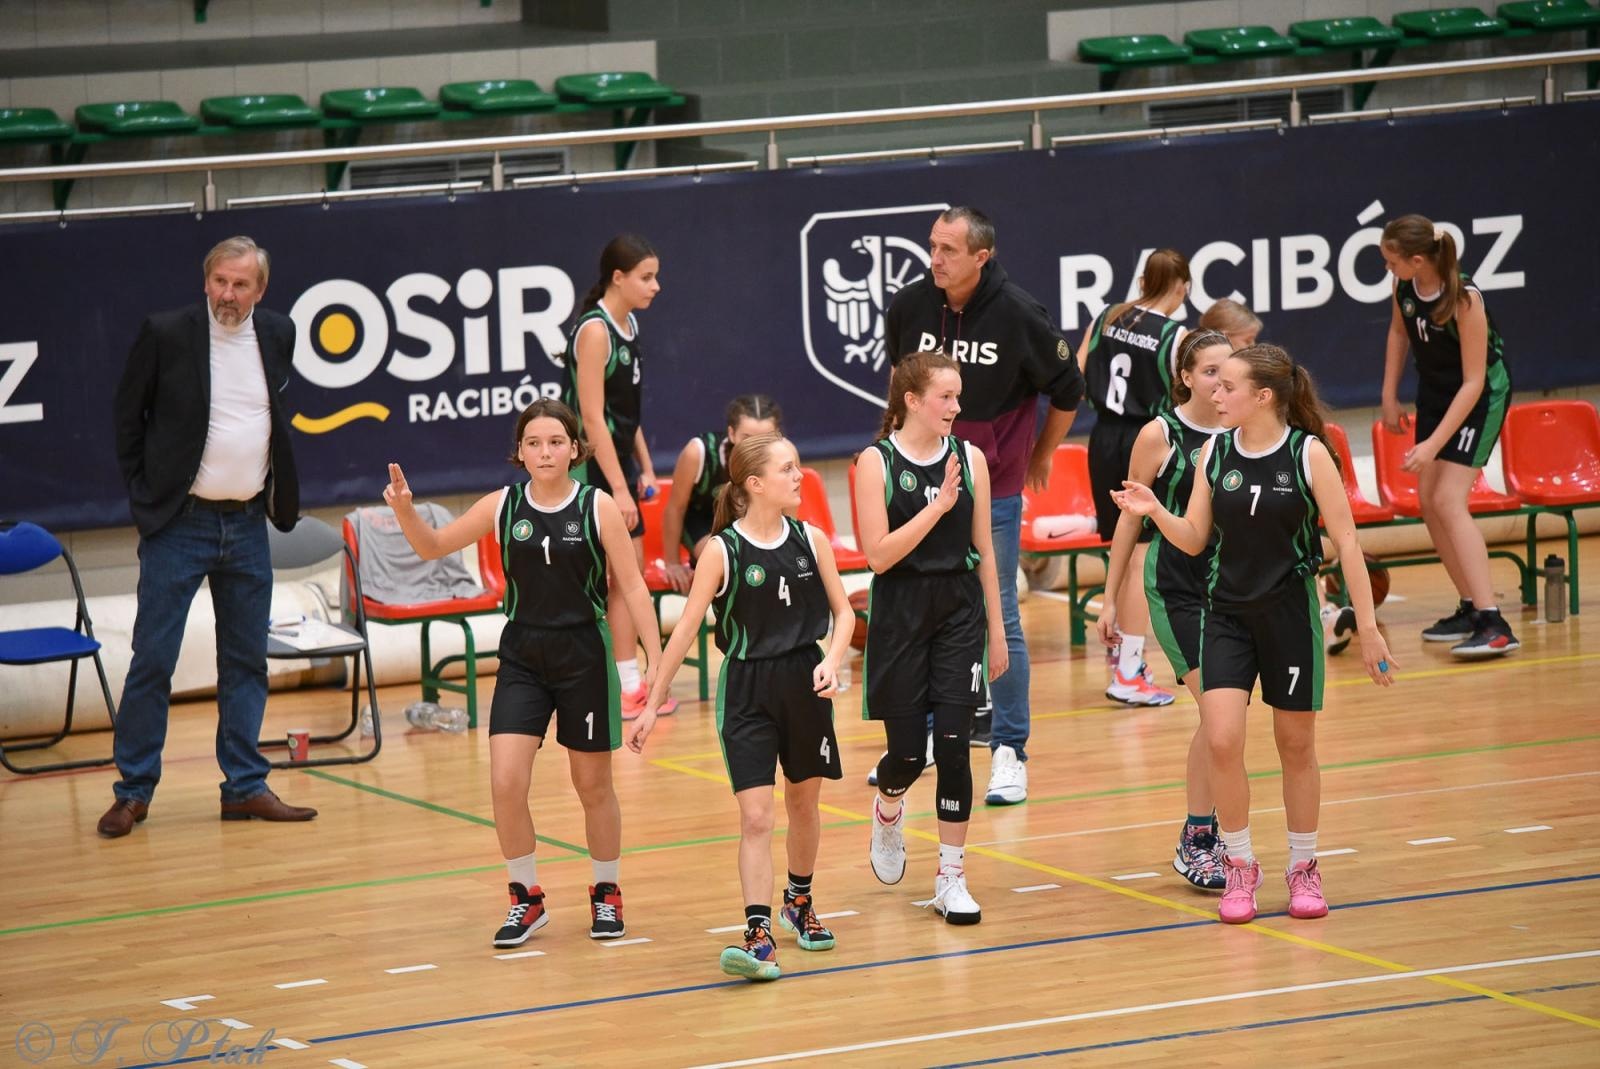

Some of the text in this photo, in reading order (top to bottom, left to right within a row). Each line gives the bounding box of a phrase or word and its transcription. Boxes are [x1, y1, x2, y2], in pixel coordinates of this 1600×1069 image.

[1060, 199, 1526, 331] RCIBÓZ
[289, 265, 576, 389] OSiR
[1416, 316, 1429, 342] 11
[0, 340, 44, 424] Z
[1105, 353, 1132, 415] 6
[1457, 426, 1476, 453] 11
[1250, 484, 1262, 516] 7
[540, 535, 551, 565] 1
[778, 575, 791, 606] 4
[970, 662, 982, 693] 10
[1288, 666, 1300, 695] 7
[585, 711, 594, 740] 1
[819, 736, 831, 764] 4
[945, 800, 960, 811] NBA
